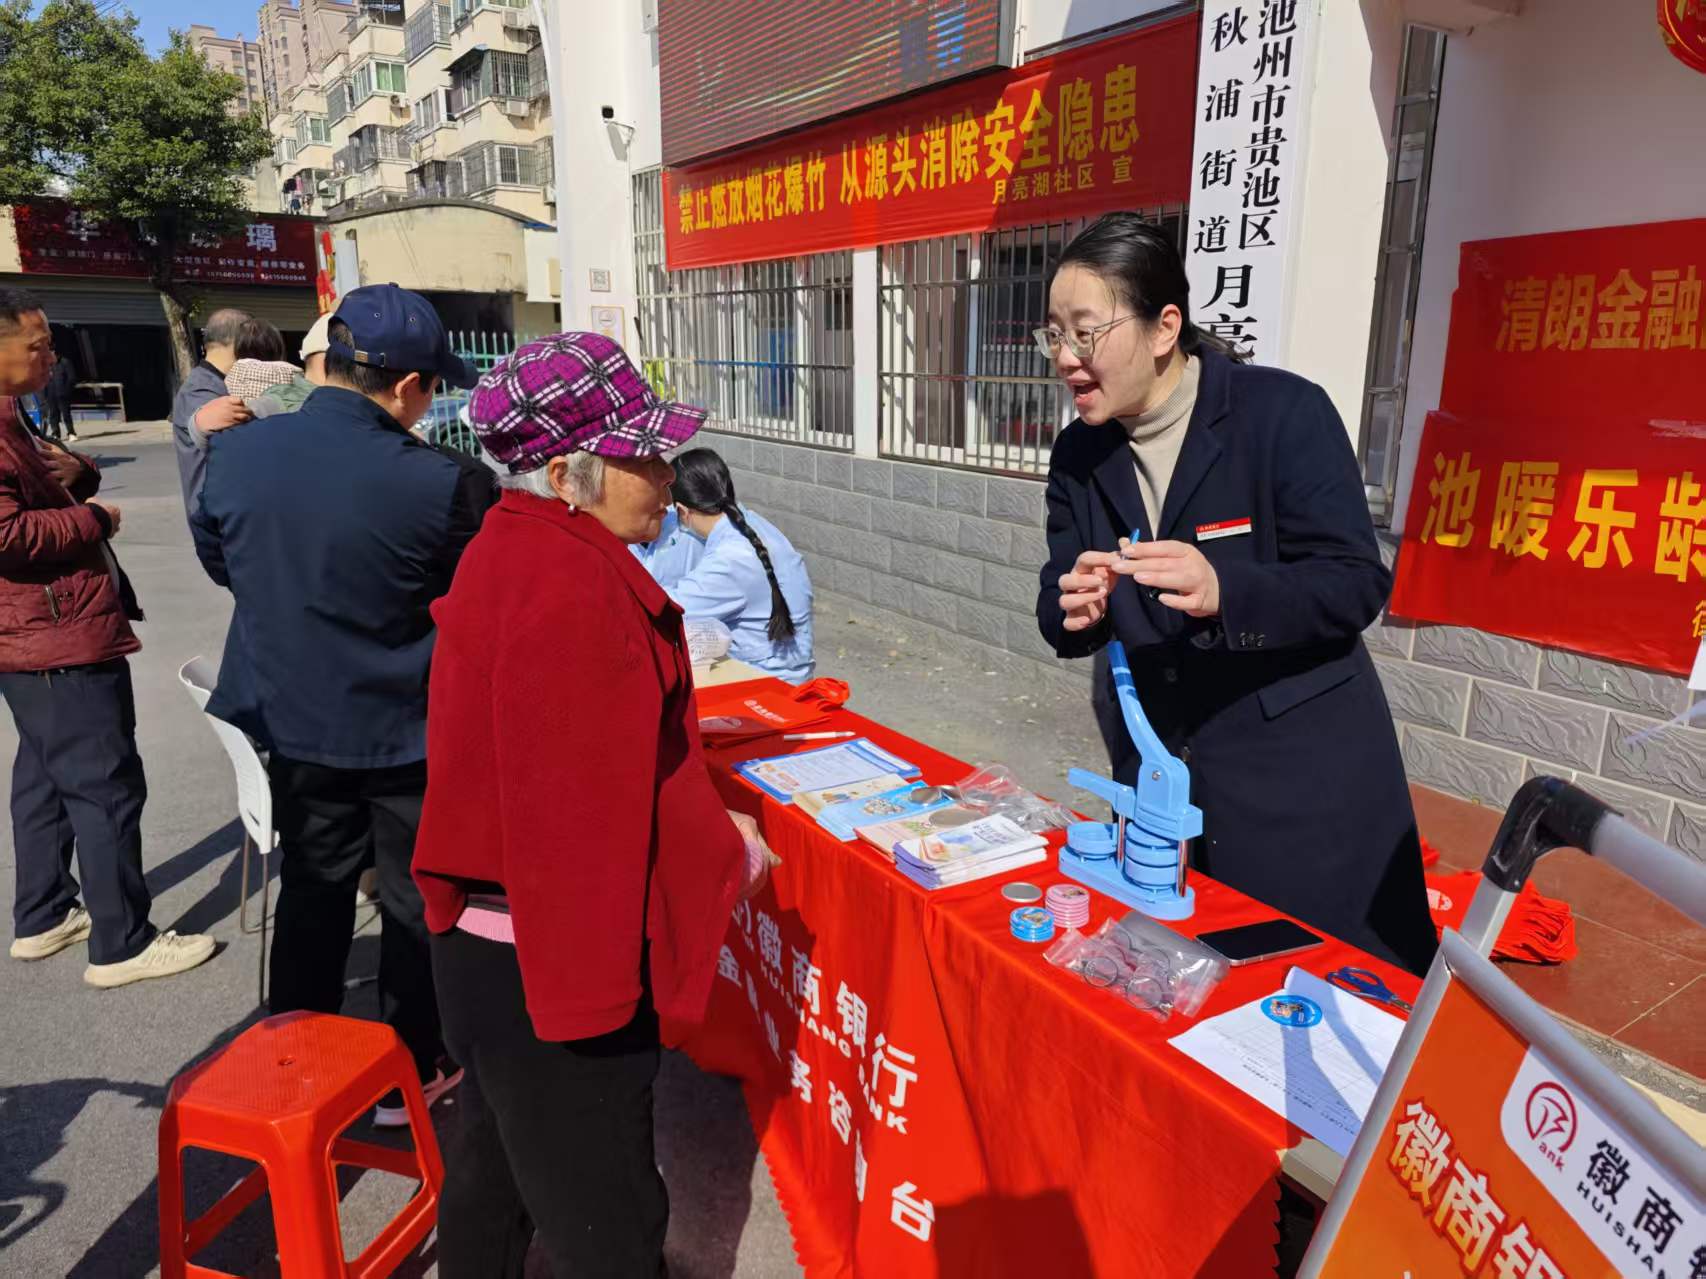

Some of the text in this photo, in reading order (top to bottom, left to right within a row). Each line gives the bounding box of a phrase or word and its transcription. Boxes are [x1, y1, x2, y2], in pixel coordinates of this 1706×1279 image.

[679, 63, 1140, 235] 禁止燃放烟花爆竹 从源头消除安全隐患
[992, 155, 1134, 204] 月亮湖社区 宣
[1194, 7, 1248, 254] 秋浦街道
[1238, 0, 1297, 250] 池州市贵池区
[1496, 265, 1698, 352] 清朗金融
[1421, 451, 1706, 583] 池暖乐龄
[757, 910, 918, 1108] 徽商银行
[1576, 1181, 1667, 1279] HUISHA
